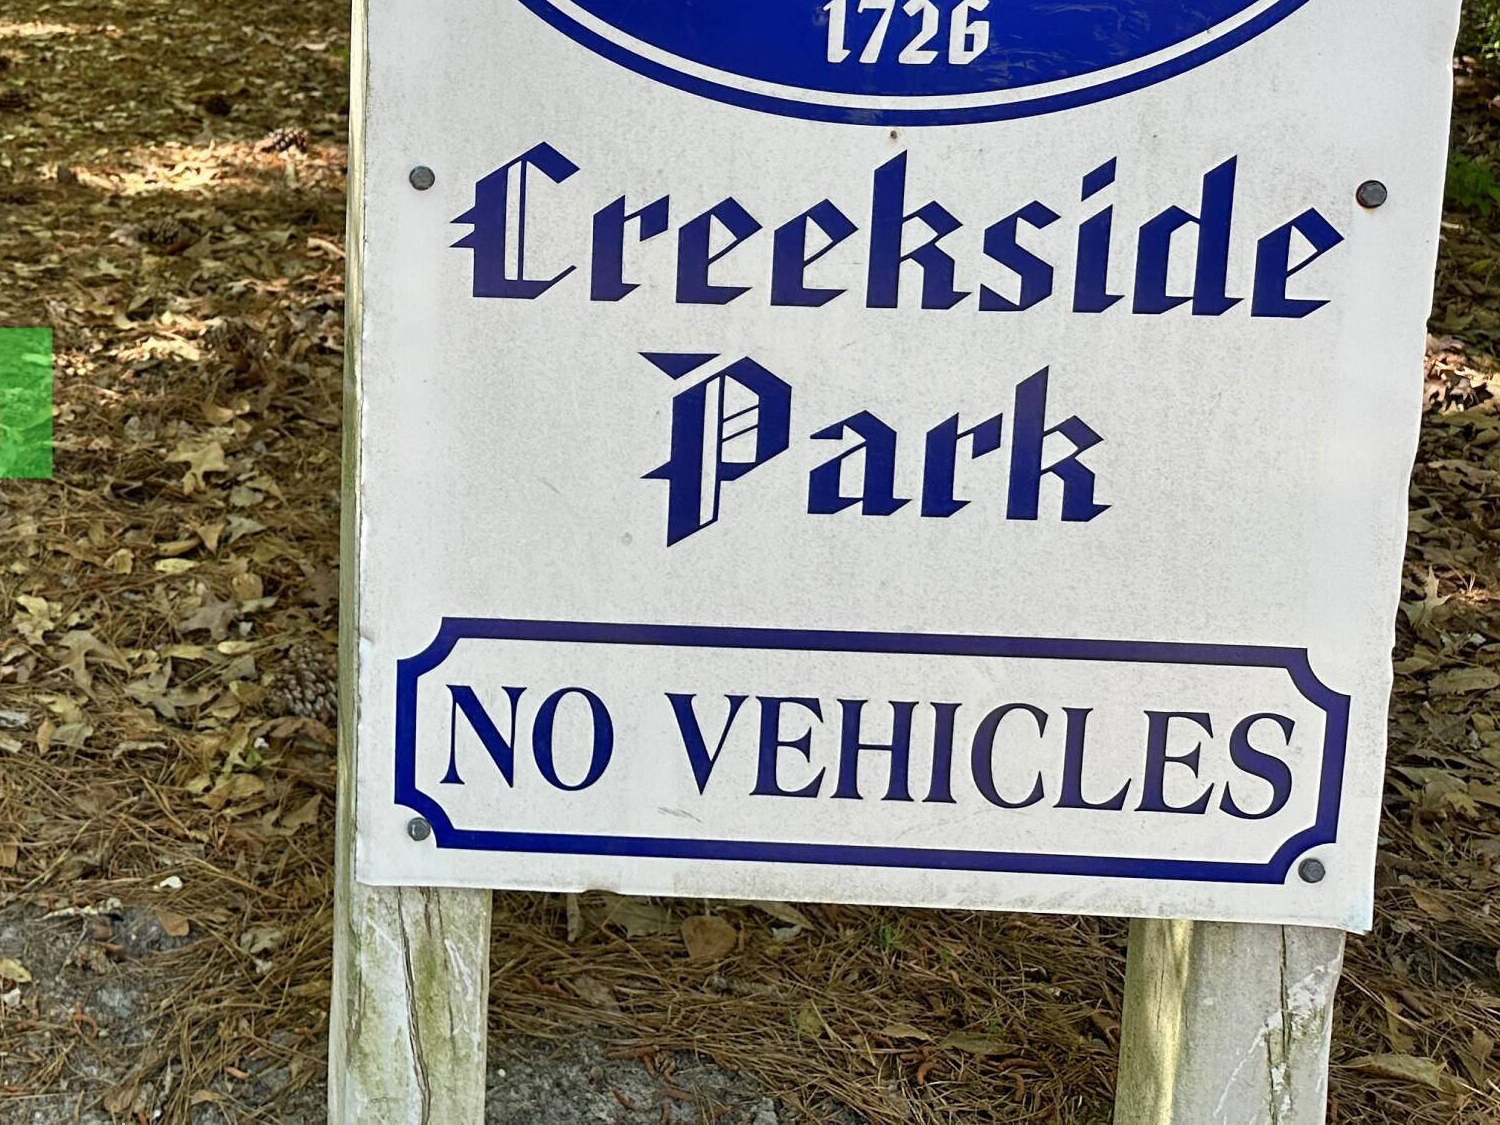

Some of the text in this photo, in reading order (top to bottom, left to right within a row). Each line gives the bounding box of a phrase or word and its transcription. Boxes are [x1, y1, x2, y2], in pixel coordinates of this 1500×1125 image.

[449, 141, 1345, 318] Creekside
[639, 352, 1111, 547] Park
[439, 685, 1296, 819] NO VEHICLES
